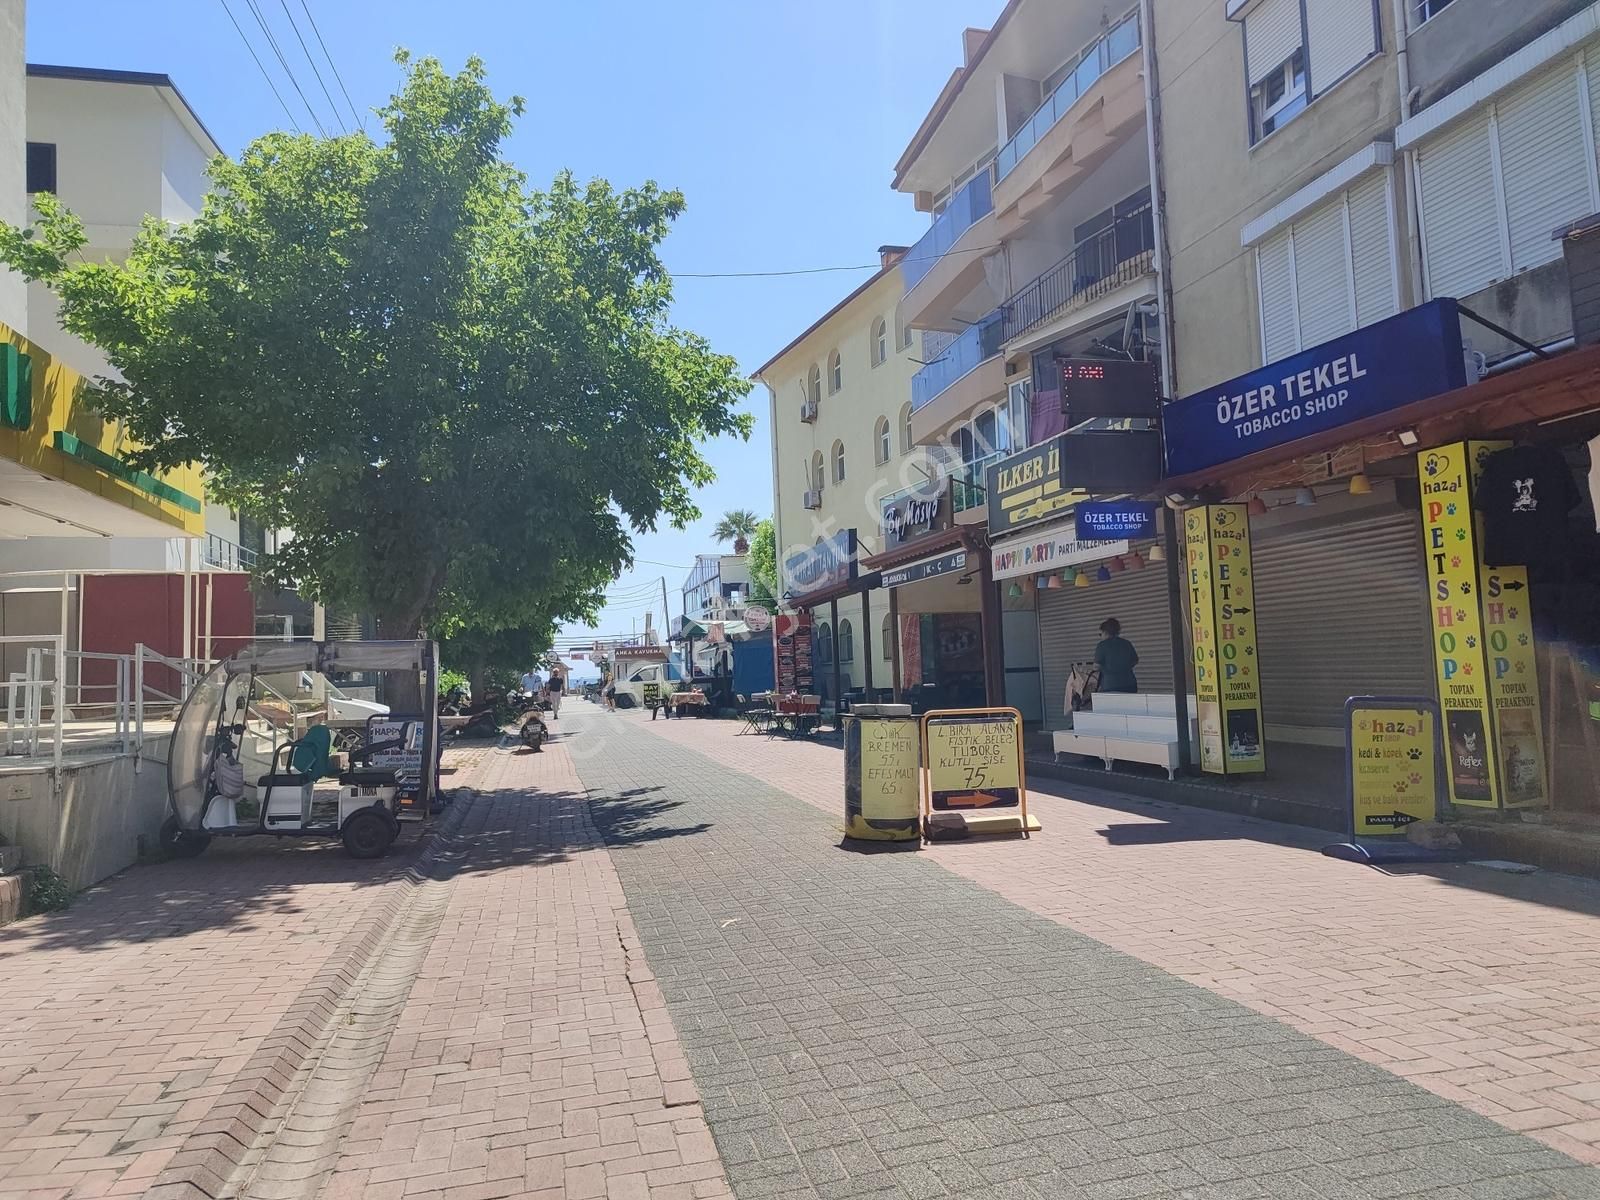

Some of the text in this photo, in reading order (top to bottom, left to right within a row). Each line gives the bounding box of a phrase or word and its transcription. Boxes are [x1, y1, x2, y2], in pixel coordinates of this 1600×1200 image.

[1217, 352, 1367, 424] ÖZER TEKEL
[1234, 389, 1350, 439] TOBACCO SHOP
[997, 456, 1044, 494] İLKER
[1424, 475, 1463, 495] hazal
[885, 507, 901, 540] By
[1084, 511, 1149, 524] ÖZER TEKEL
[1093, 522, 1142, 531] TOBACCO SHOP
[1213, 528, 1247, 541] hazal
[995, 548, 1023, 572] HAPPY
[1025, 541, 1056, 565] PARTY
[1230, 682, 1251, 691] TOPTAN
[1449, 684, 1475, 696] TOPTAN
[1500, 683, 1528, 695] TOPTAN
[1225, 692, 1257, 701] PERAKENDE
[1495, 695, 1536, 708] PERAKENDE
[1444, 697, 1484, 709] PERAKENDE
[980, 723, 1014, 735] ALANA
[1372, 718, 1424, 737] hazal
[1372, 734, 1383, 743] PET
[868, 741, 912, 752] BREMEN
[951, 745, 1001, 757] TUBORG
[1359, 748, 1373, 759] kedi
[1374, 748, 1382, 759] &
[1459, 754, 1482, 769] Reflex
[894, 767, 914, 779] MALT
[963, 767, 989, 789] 75
